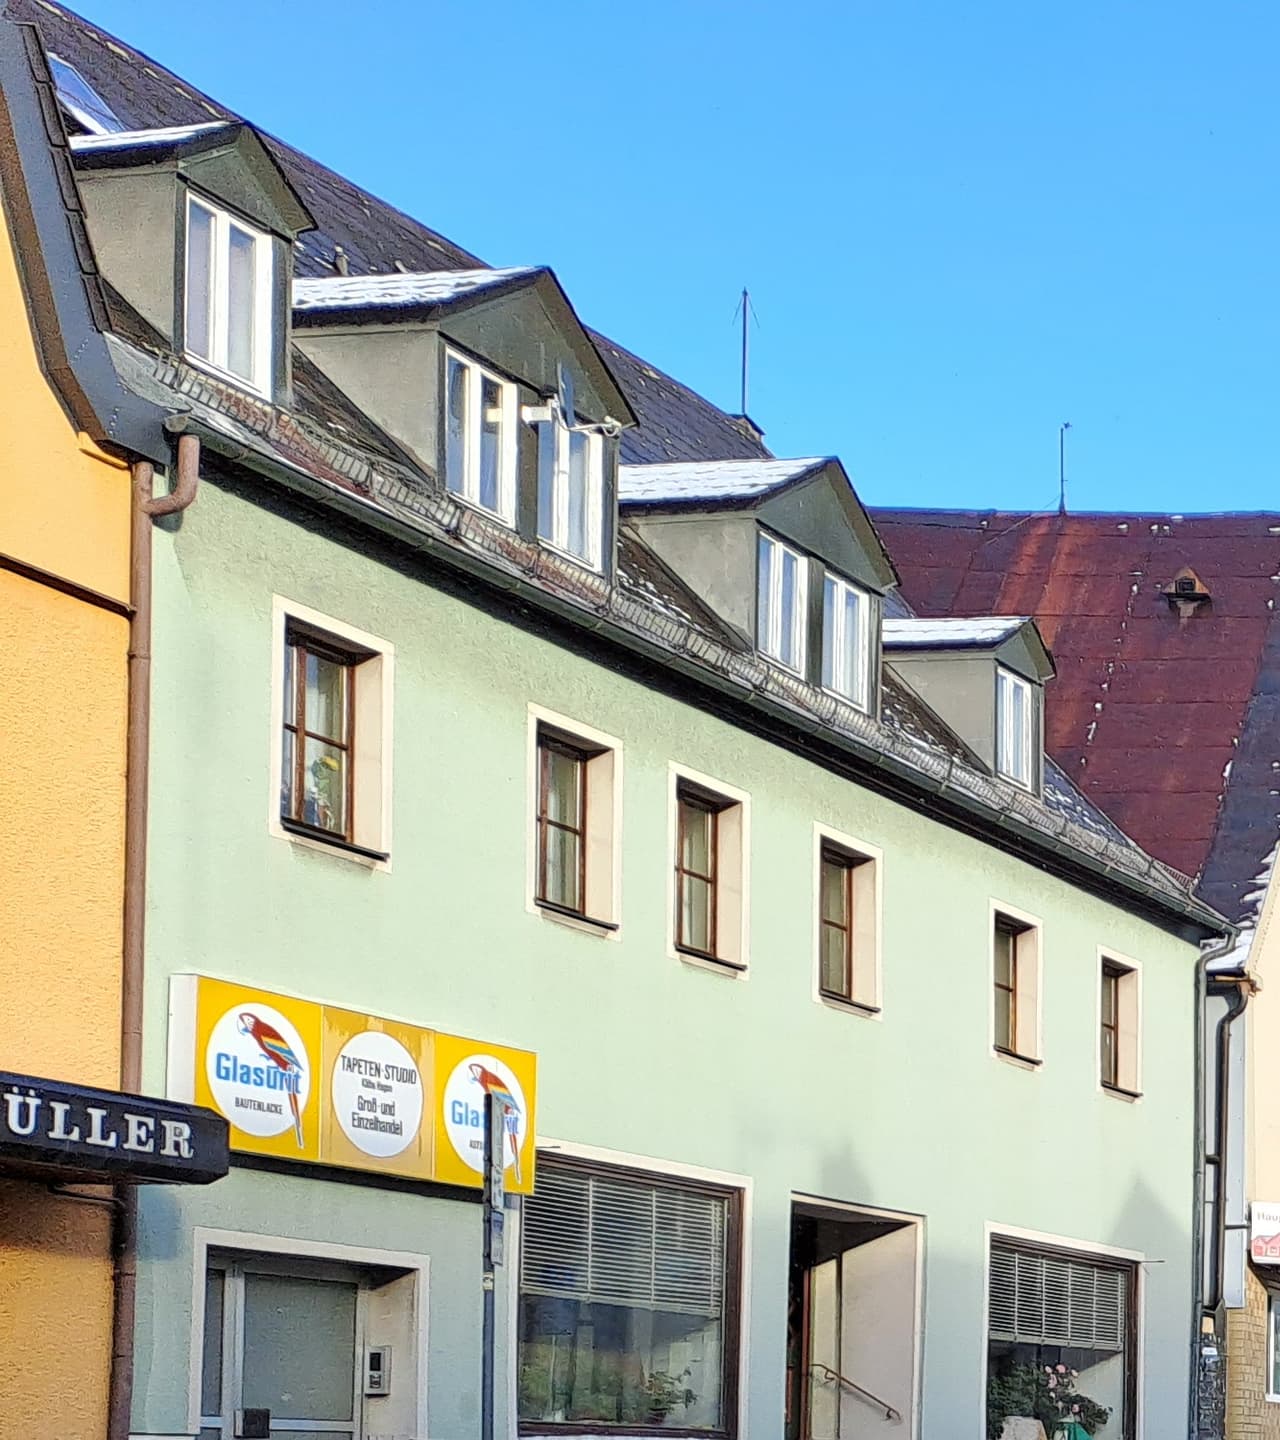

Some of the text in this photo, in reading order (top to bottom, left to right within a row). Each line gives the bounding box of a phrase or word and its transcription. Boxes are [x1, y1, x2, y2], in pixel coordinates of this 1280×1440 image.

[215, 1052, 302, 1094] Glasurit
[4, 1086, 194, 1159] ÜLLER
[351, 1112, 403, 1136] Einzelhandel
[380, 1101, 396, 1116] und
